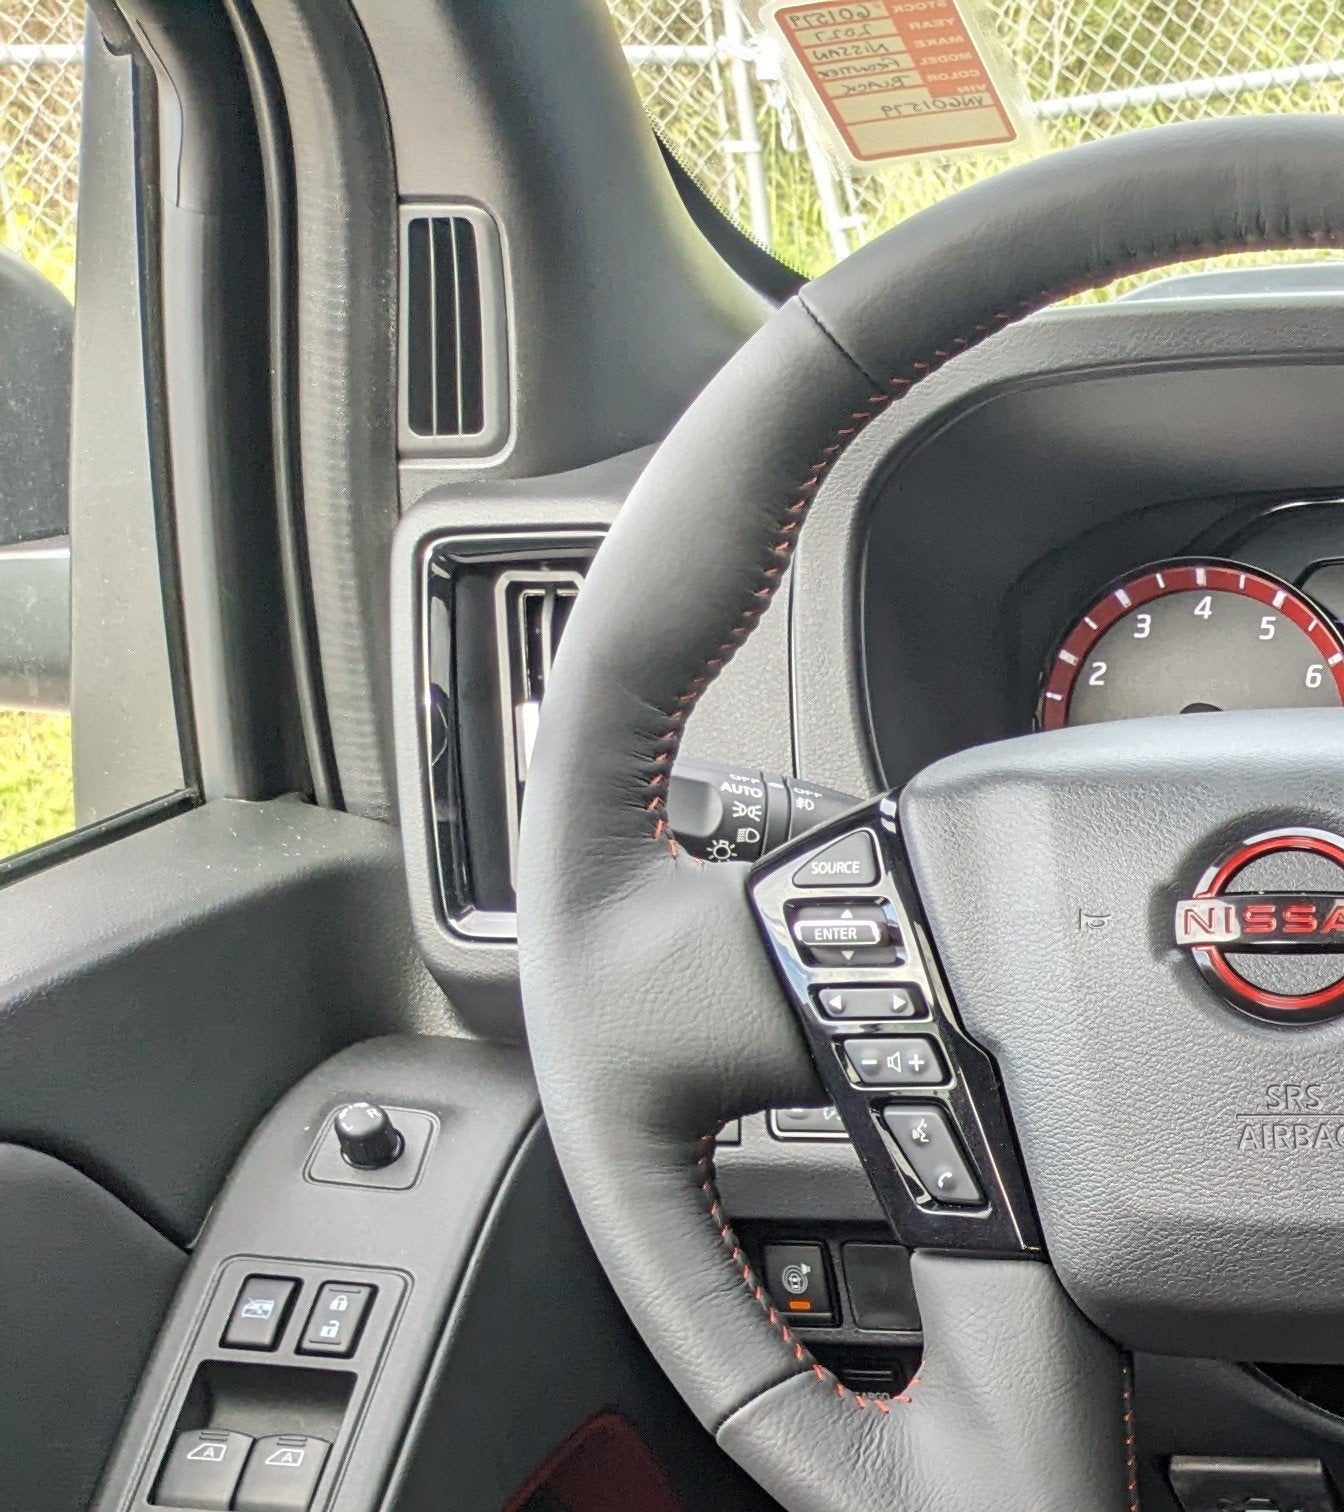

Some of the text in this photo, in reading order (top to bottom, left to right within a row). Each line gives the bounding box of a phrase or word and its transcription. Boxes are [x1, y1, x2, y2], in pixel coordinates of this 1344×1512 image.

[1193, 596, 1213, 619] 4
[1133, 614, 1152, 639] 3
[1259, 616, 1277, 641] 5
[1088, 662, 1108, 686] 2
[1305, 664, 1324, 688] 6
[720, 782, 763, 798] AUTO
[810, 861, 860, 875] SOURCE
[814, 927, 858, 941] ENTER
[1266, 1083, 1323, 1111] SRS
